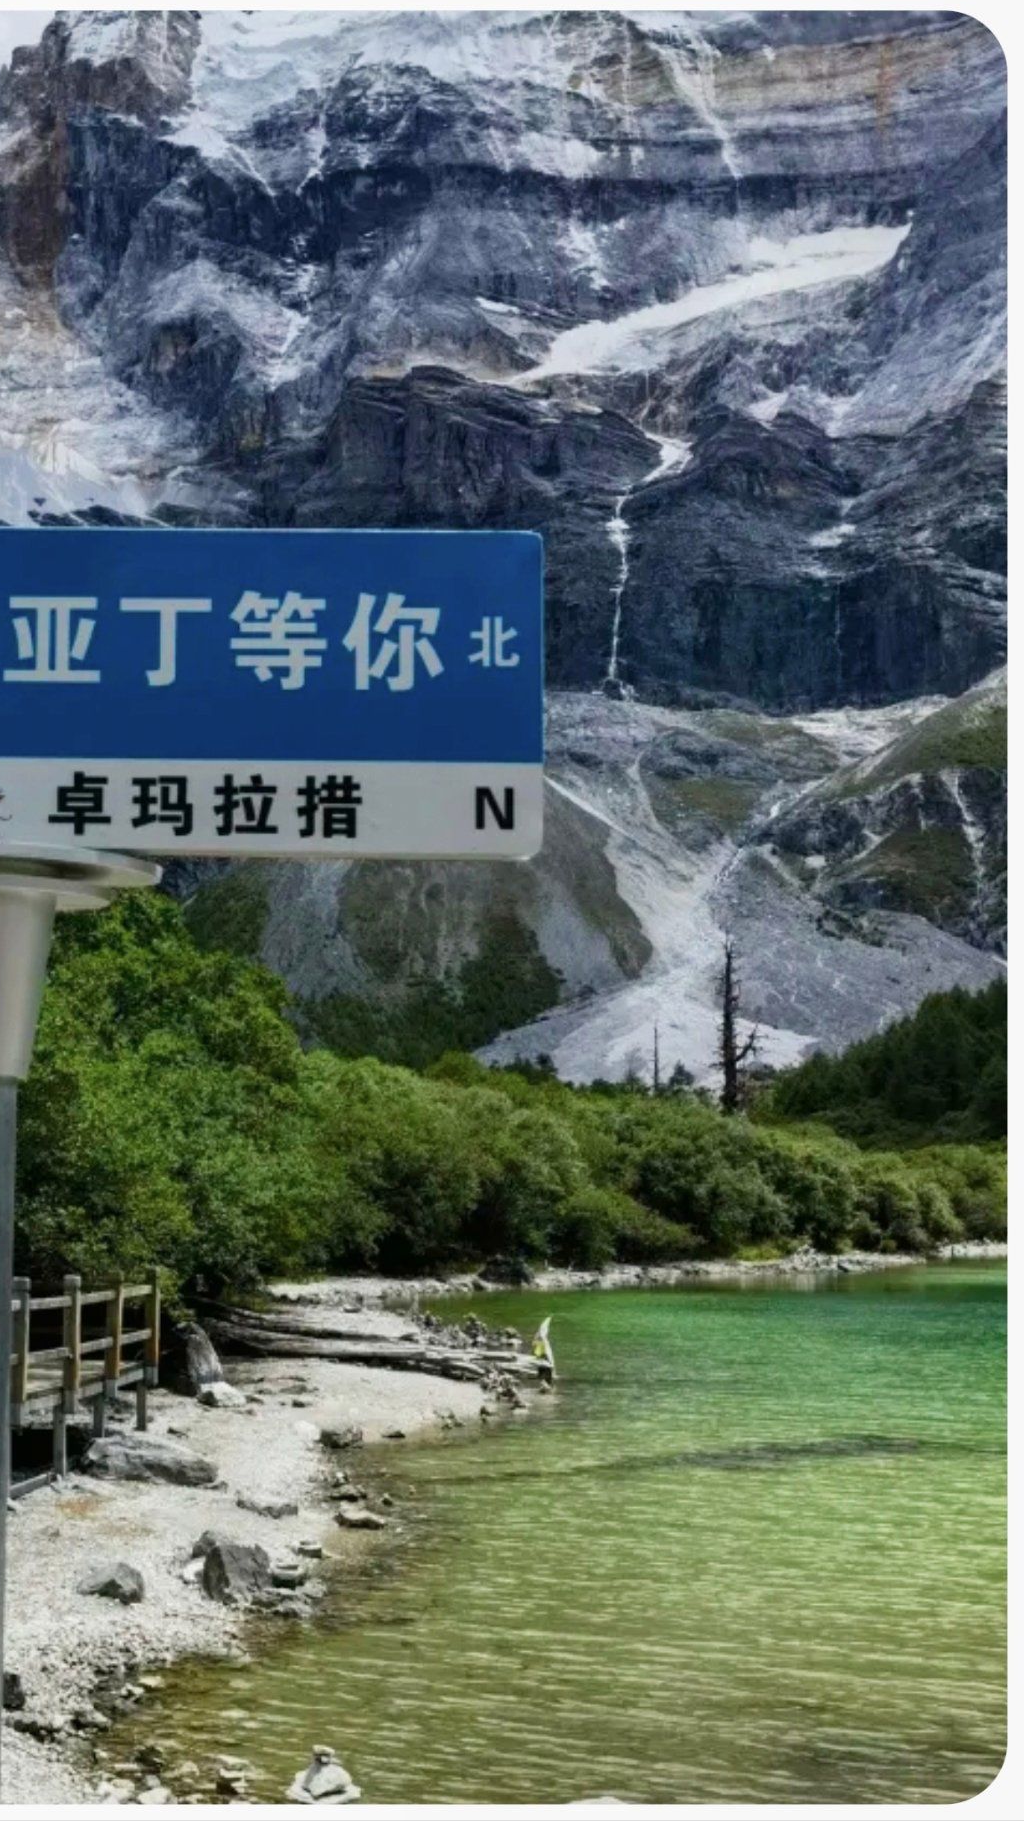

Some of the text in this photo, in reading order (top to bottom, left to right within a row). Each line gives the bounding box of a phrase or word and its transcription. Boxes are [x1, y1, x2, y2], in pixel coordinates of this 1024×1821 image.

[468, 616, 521, 667] 北
[47, 771, 363, 839] 卓玛拉措
[475, 786, 515, 830] N
